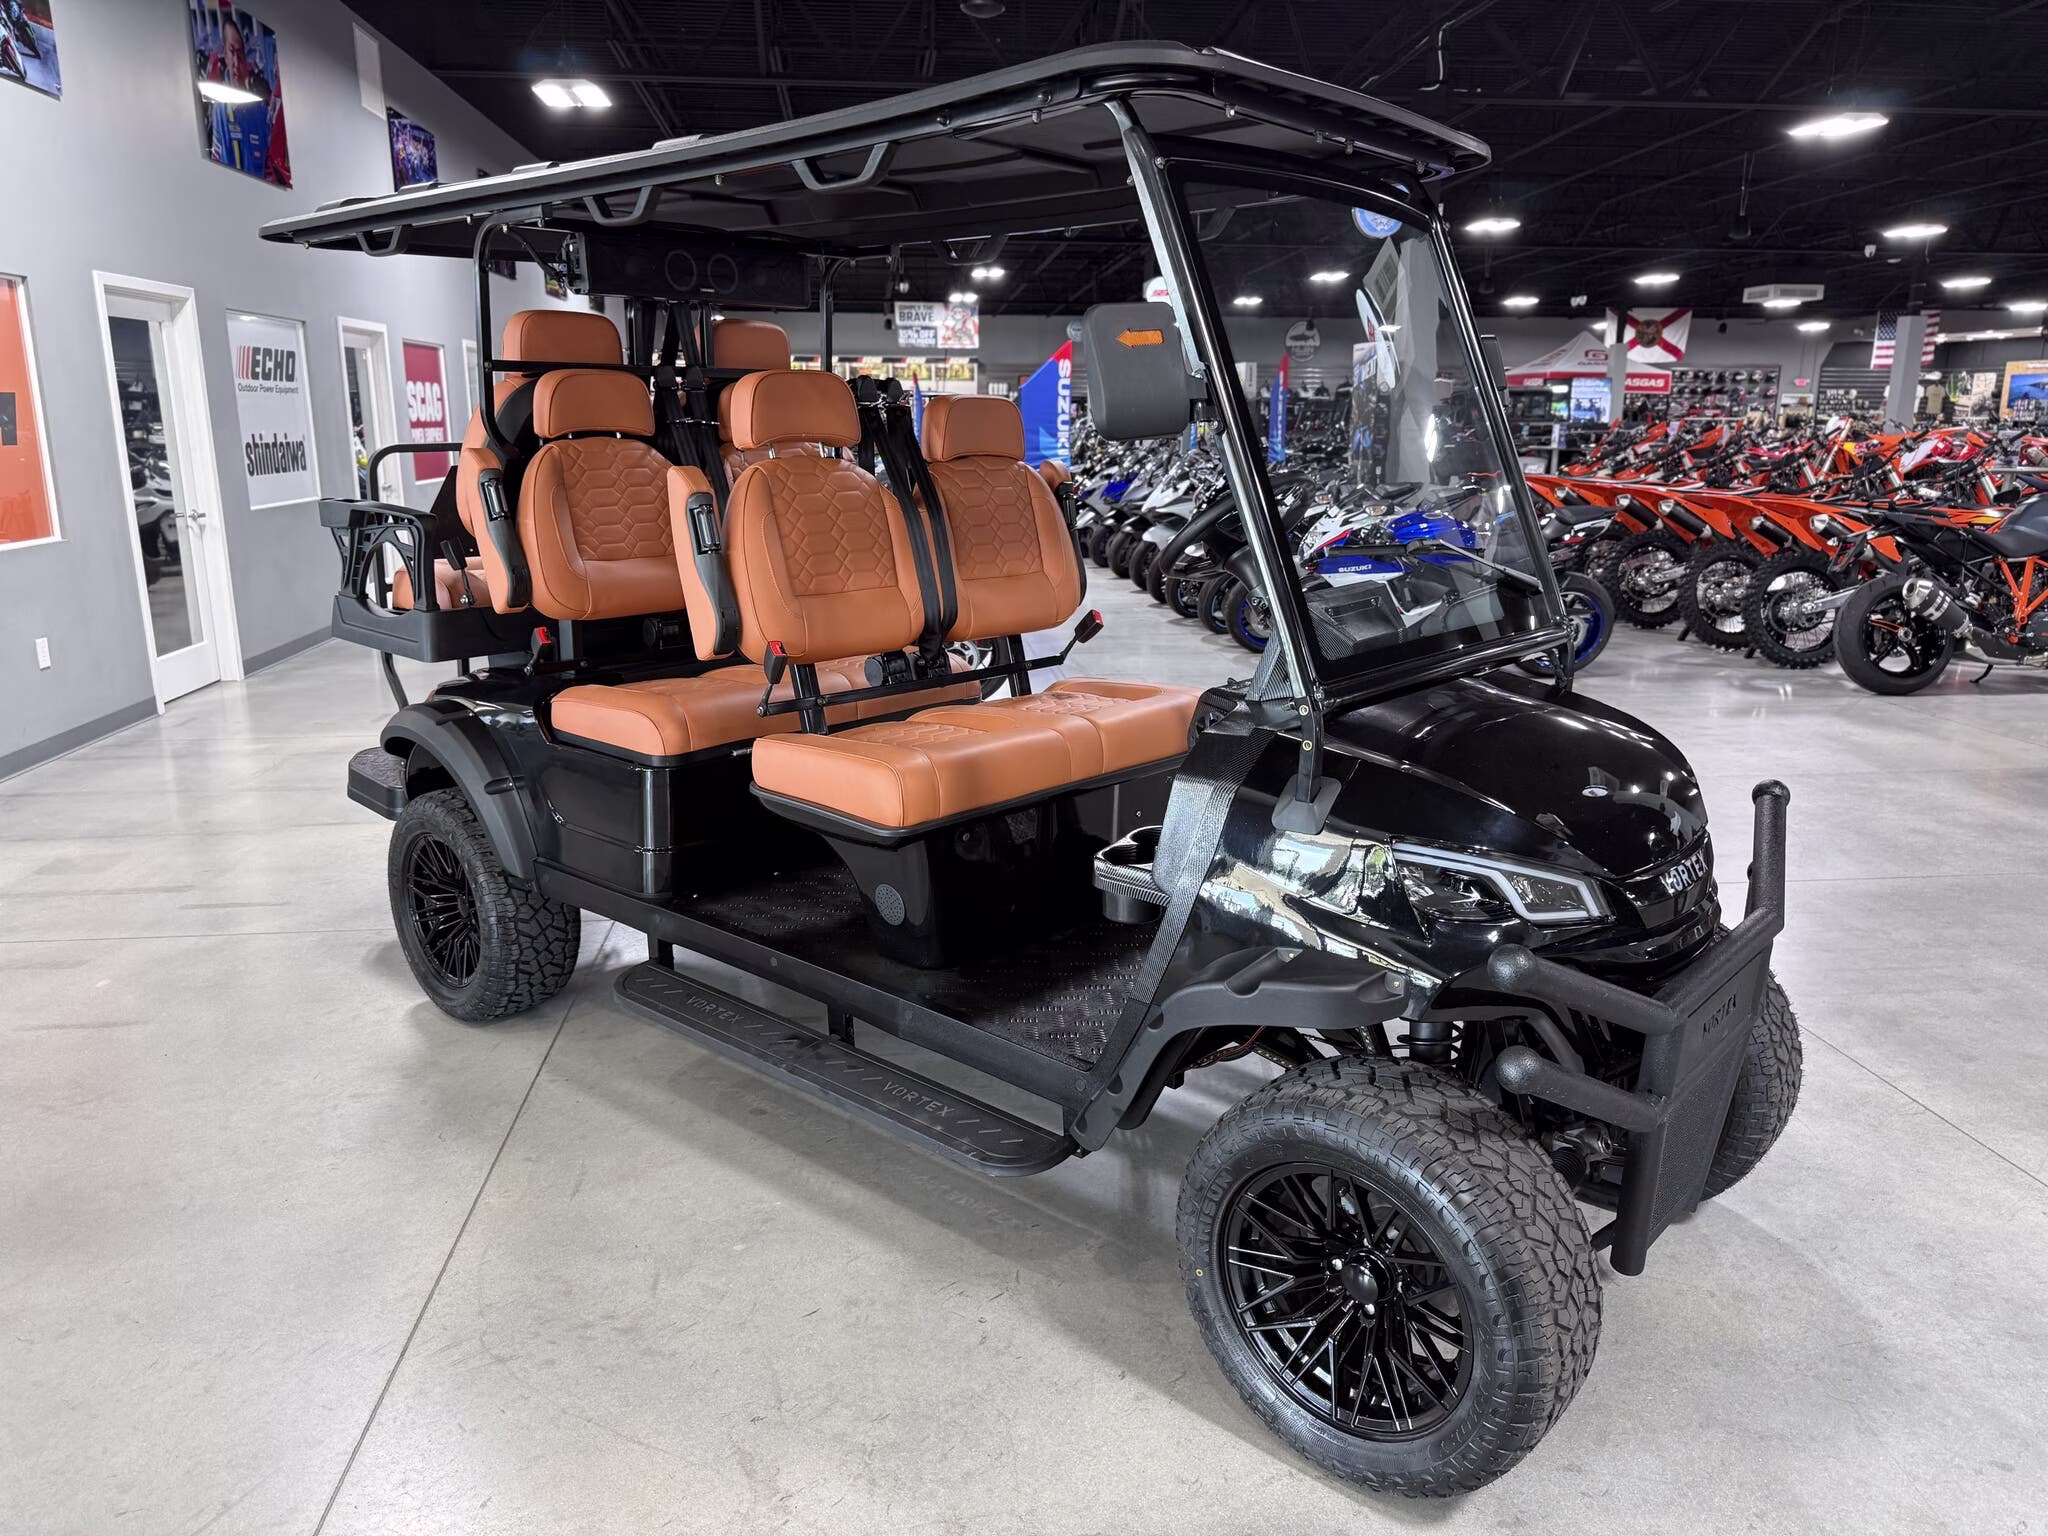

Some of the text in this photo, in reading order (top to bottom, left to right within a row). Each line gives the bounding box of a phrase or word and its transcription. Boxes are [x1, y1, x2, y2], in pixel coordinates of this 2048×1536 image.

[899, 311, 935, 322] BRAVE
[250, 346, 297, 382] ECHO
[238, 382, 299, 395] Outdoor Power Equipment
[1625, 377, 1665, 388] ASGAS
[406, 380, 443, 422] SCAG
[1057, 358, 1072, 457] SUZUKI
[245, 433, 307, 477] shindaiwa
[1338, 563, 1372, 573] SUZUKI
[1659, 850, 1709, 896] VORTEX
[686, 995, 745, 1024] VORTEX
[882, 1081, 956, 1118] VORTEX
